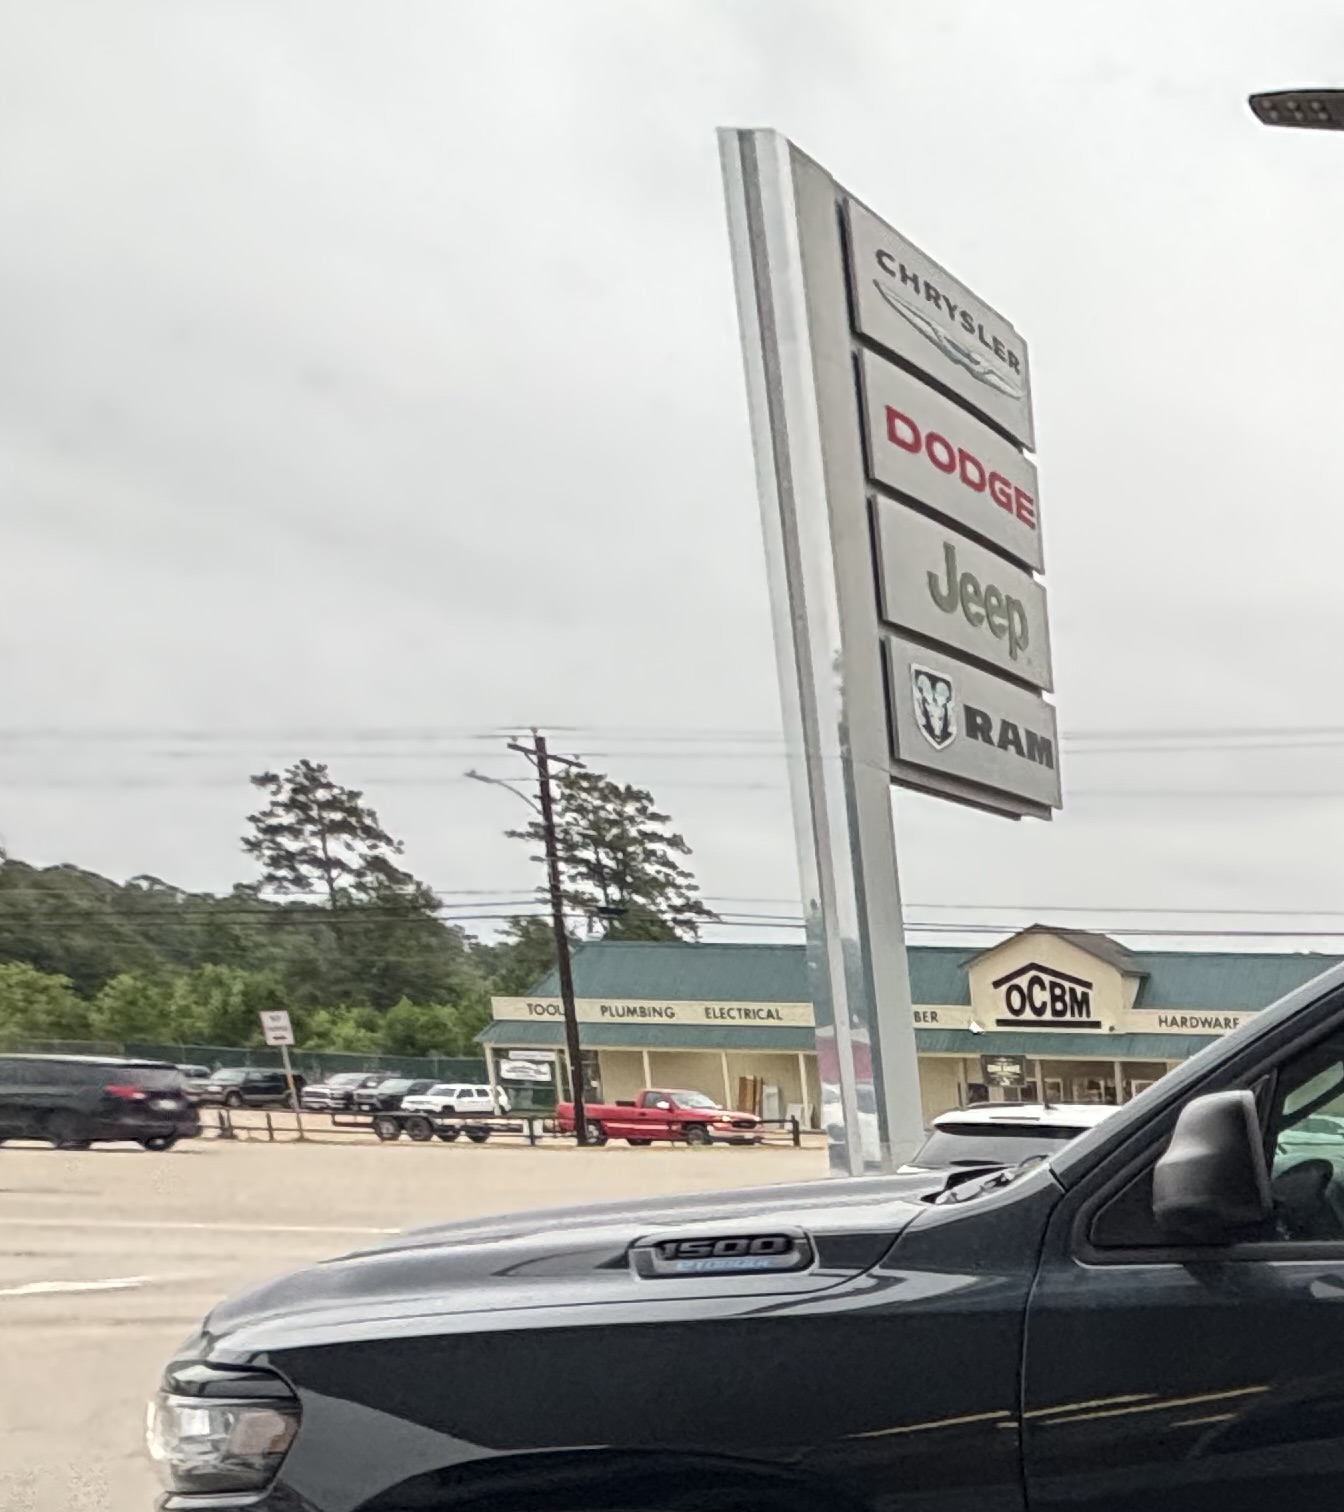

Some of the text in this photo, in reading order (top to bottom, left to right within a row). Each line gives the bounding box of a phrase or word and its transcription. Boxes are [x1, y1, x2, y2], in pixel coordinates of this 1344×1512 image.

[875, 247, 1021, 376] CHRYSLER
[884, 405, 1036, 530] DODGE
[926, 541, 1029, 662] Jeep
[963, 703, 1054, 770] RAM
[600, 1004, 676, 1020] PLUMBING
[704, 1006, 784, 1021] ELECTRICAL
[1005, 975, 1092, 1020] OCBM
[658, 1236, 785, 1259] 1500
